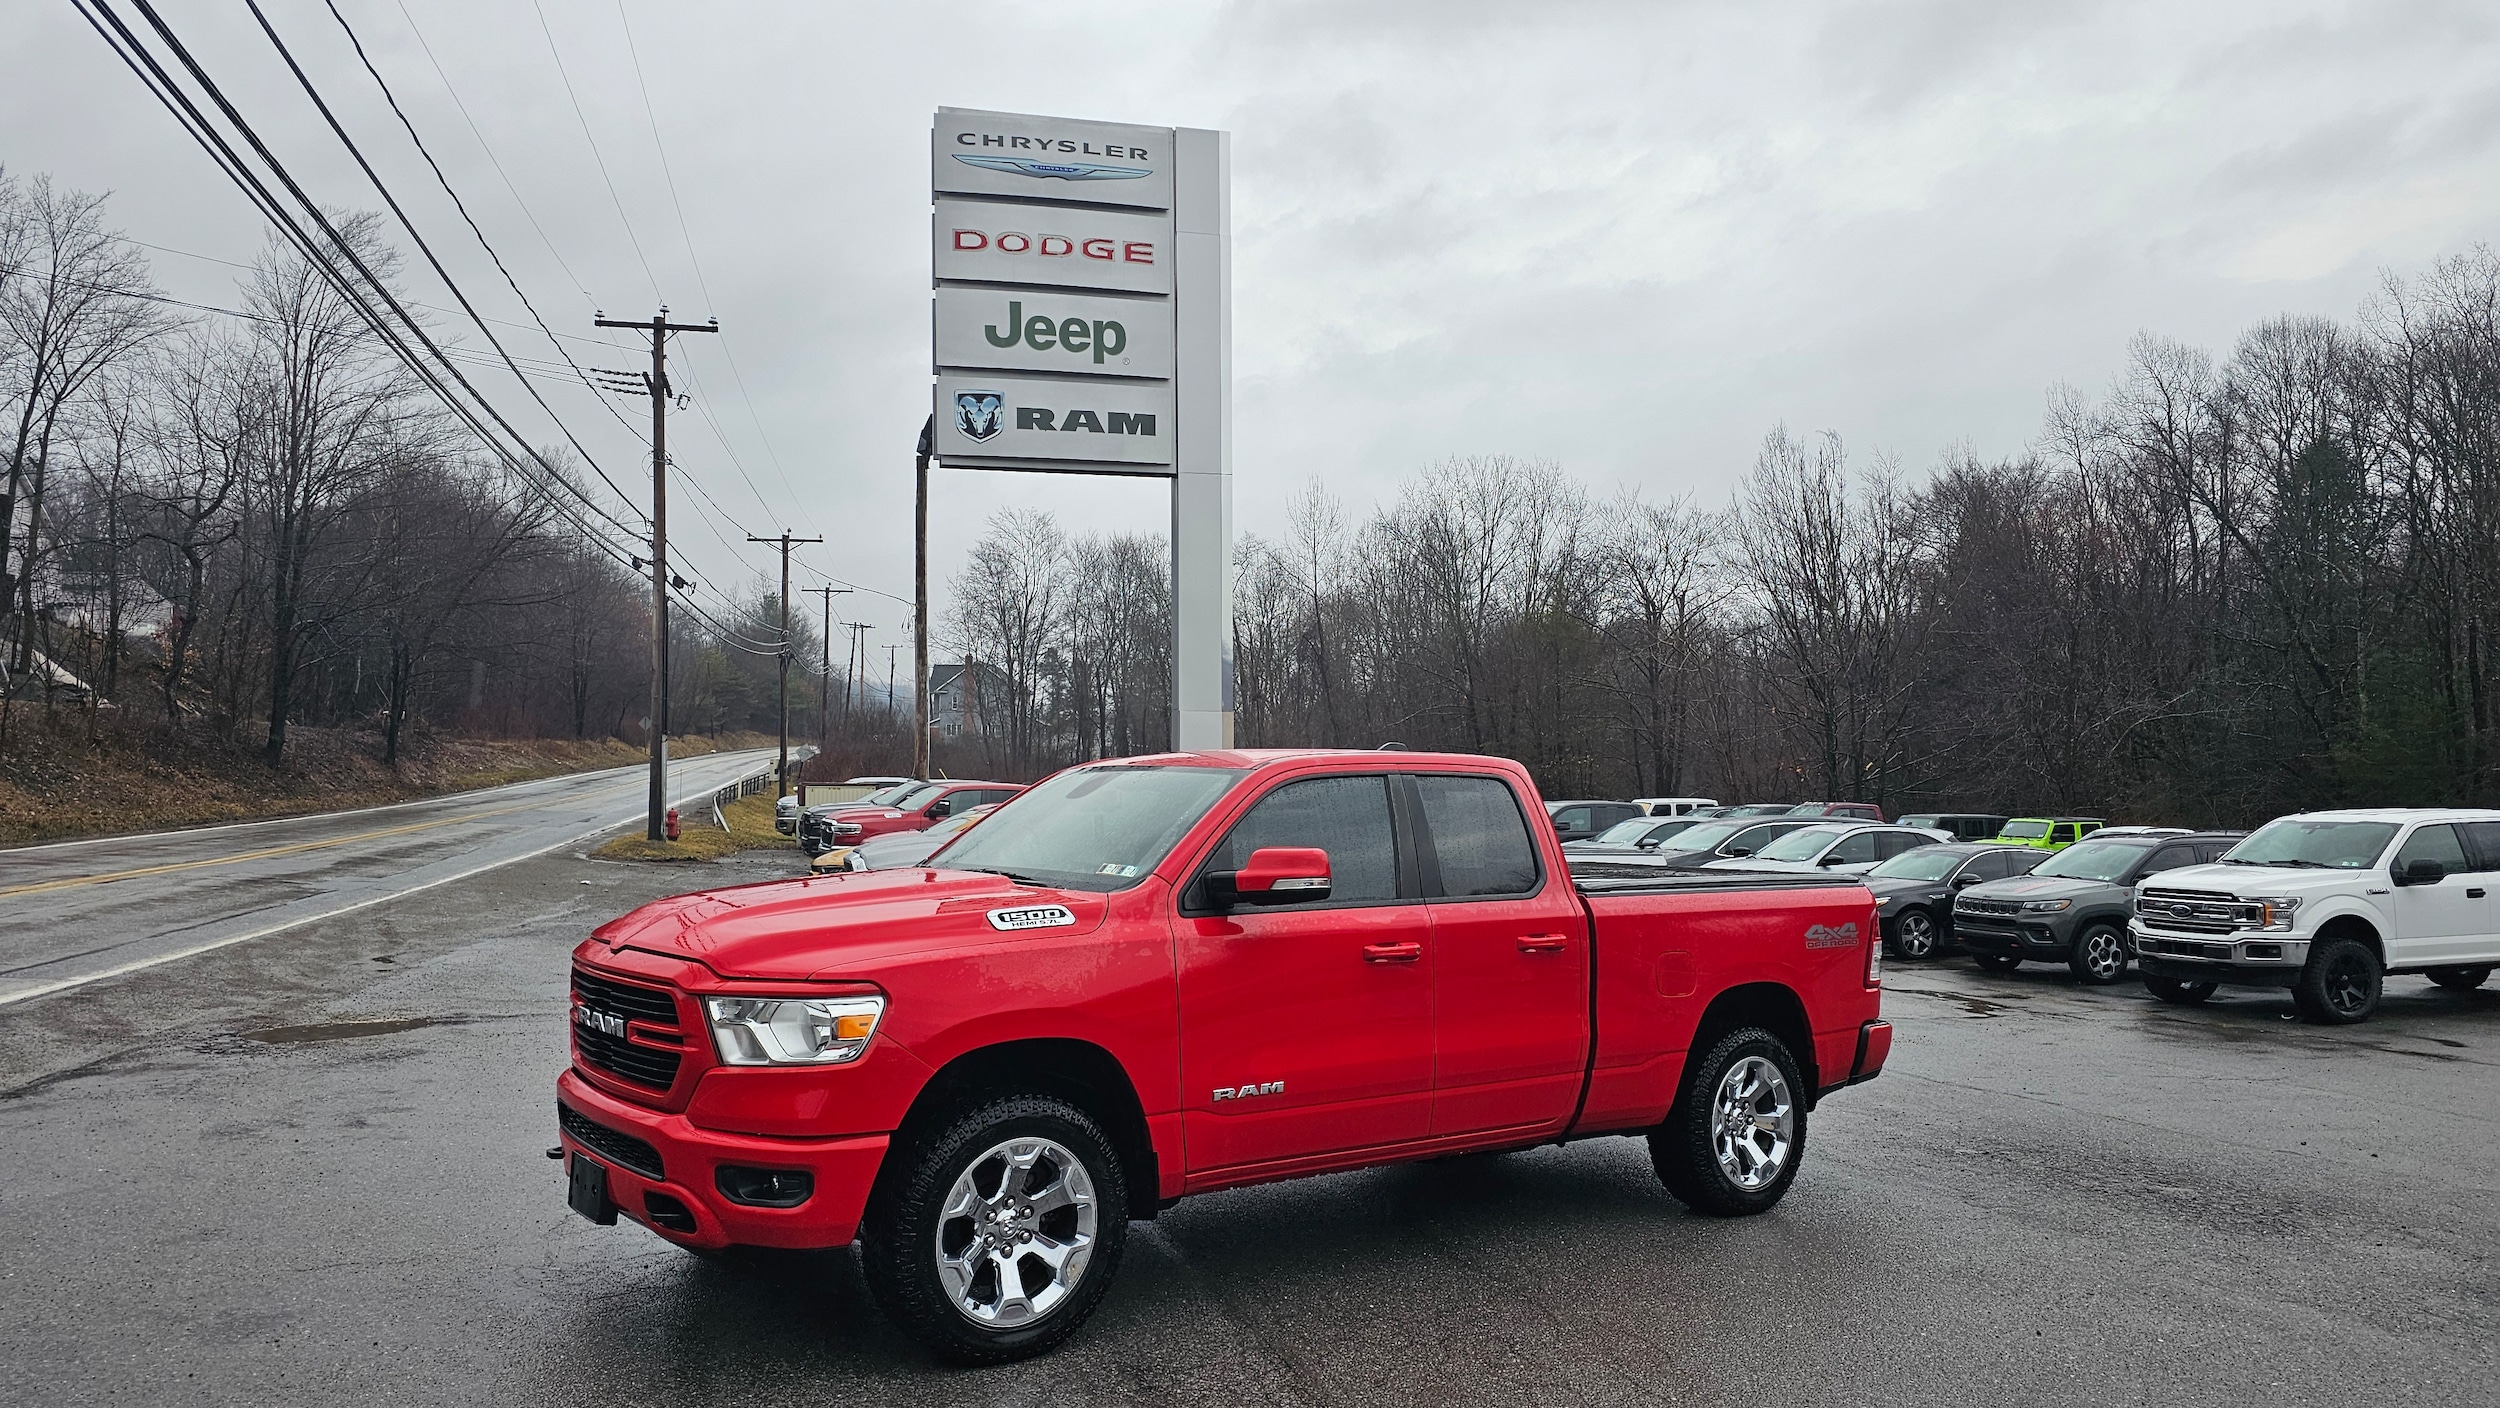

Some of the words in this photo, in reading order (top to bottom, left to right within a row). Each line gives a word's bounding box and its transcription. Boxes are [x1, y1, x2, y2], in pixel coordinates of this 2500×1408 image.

[956, 133, 1149, 161] CHRYSLER
[952, 228, 1155, 266] DODGE
[984, 301, 1127, 364] Jeep
[1016, 407, 1157, 436] RAM
[1001, 909, 1061, 922] 1500
[1807, 941, 1828, 949] OFF
[578, 1005, 624, 1038] RAM
[1213, 1081, 1285, 1102] RAM
